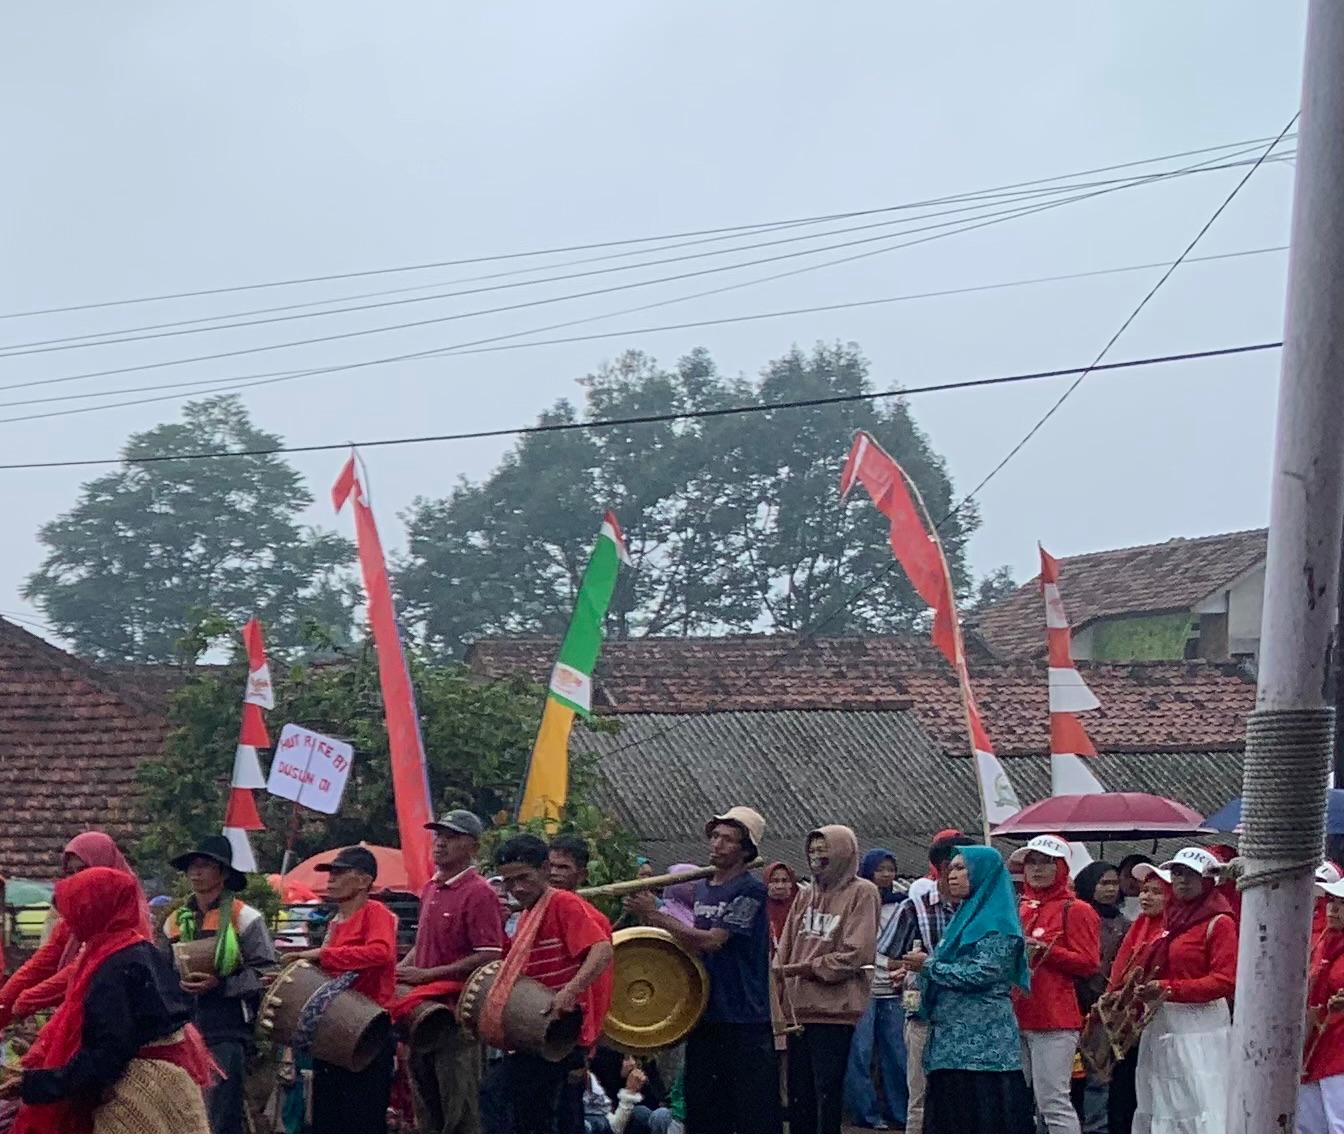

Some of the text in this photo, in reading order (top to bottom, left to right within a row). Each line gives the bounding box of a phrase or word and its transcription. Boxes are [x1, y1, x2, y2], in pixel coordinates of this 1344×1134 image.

[280, 734, 300, 751] HUT
[317, 742, 334, 758] KE
[278, 761, 315, 785] DUSUN
